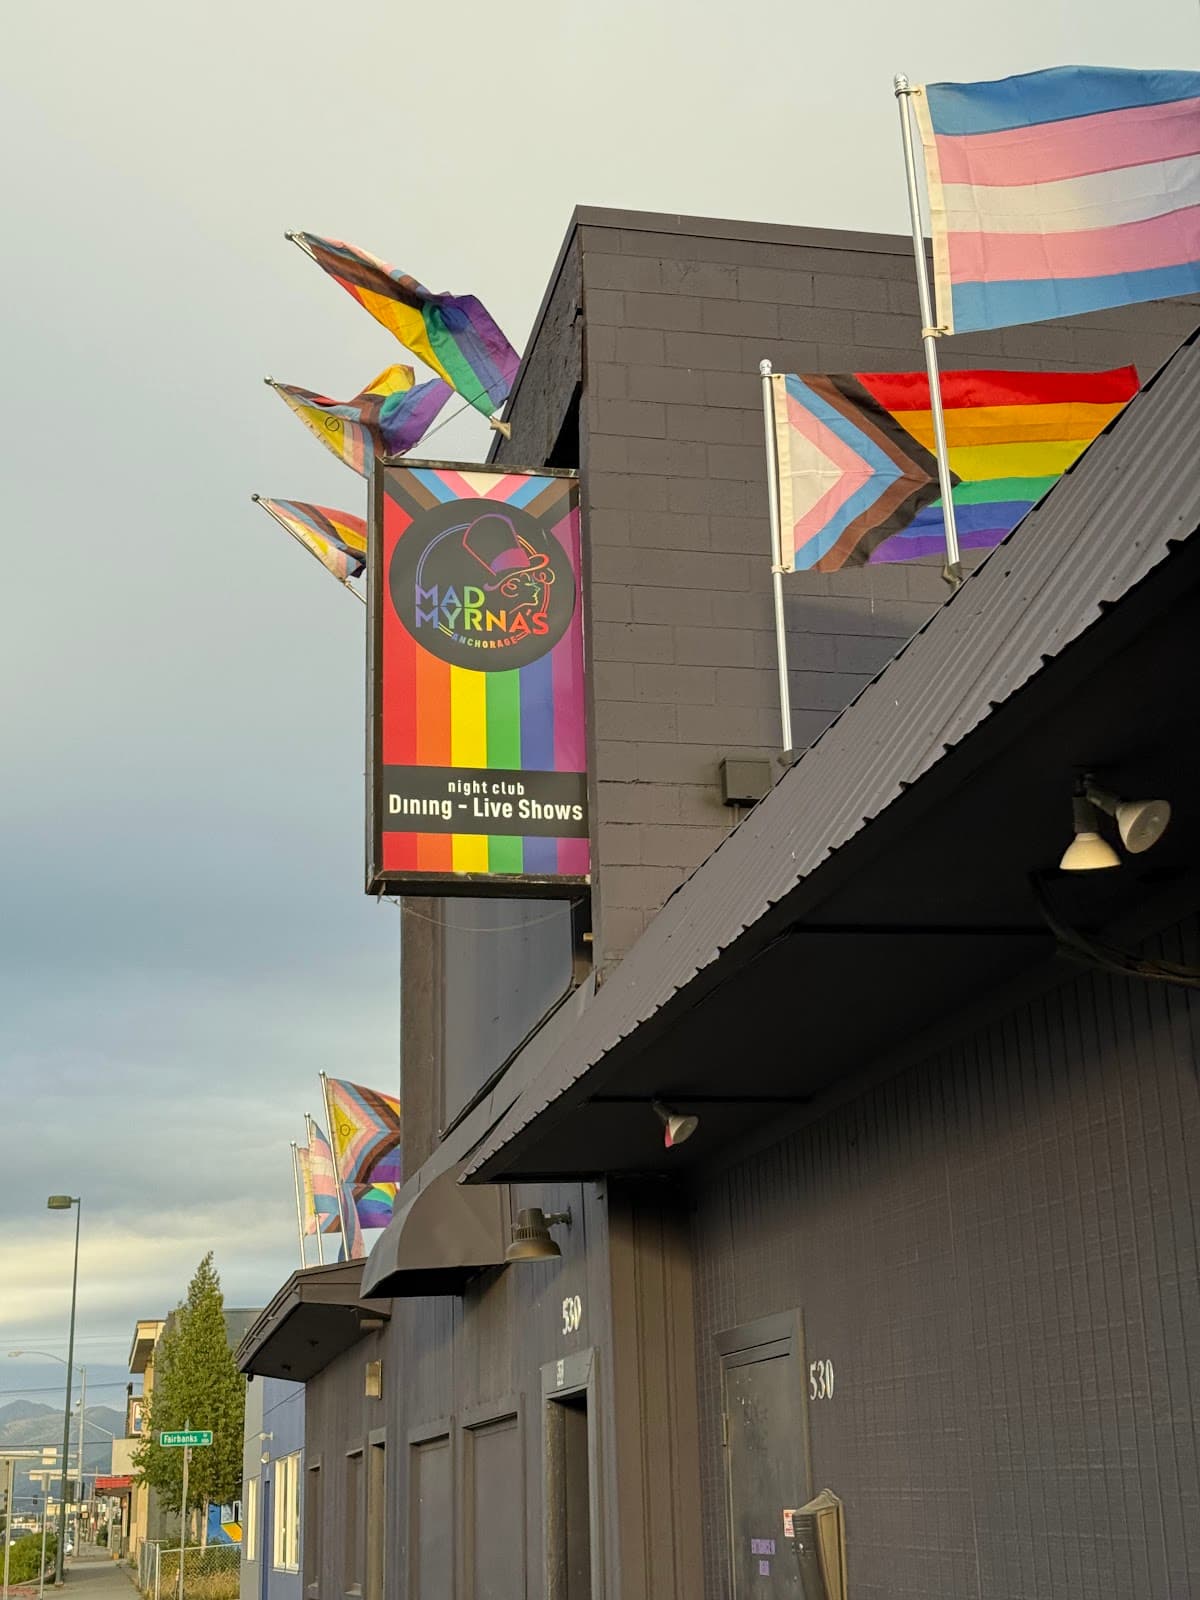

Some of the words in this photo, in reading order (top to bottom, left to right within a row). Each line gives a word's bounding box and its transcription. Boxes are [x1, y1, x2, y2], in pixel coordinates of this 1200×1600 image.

[415, 584, 485, 608] MAD
[415, 606, 549, 635] MYRNA'S
[452, 633, 518, 648] ANCHORAGE
[448, 780, 487, 795] night
[492, 781, 525, 795] club
[473, 797, 513, 818] Live
[518, 799, 583, 820] Shows
[562, 1295, 582, 1335] 530
[809, 1359, 834, 1400] 530
[164, 1434, 197, 1443] Fairbanks
